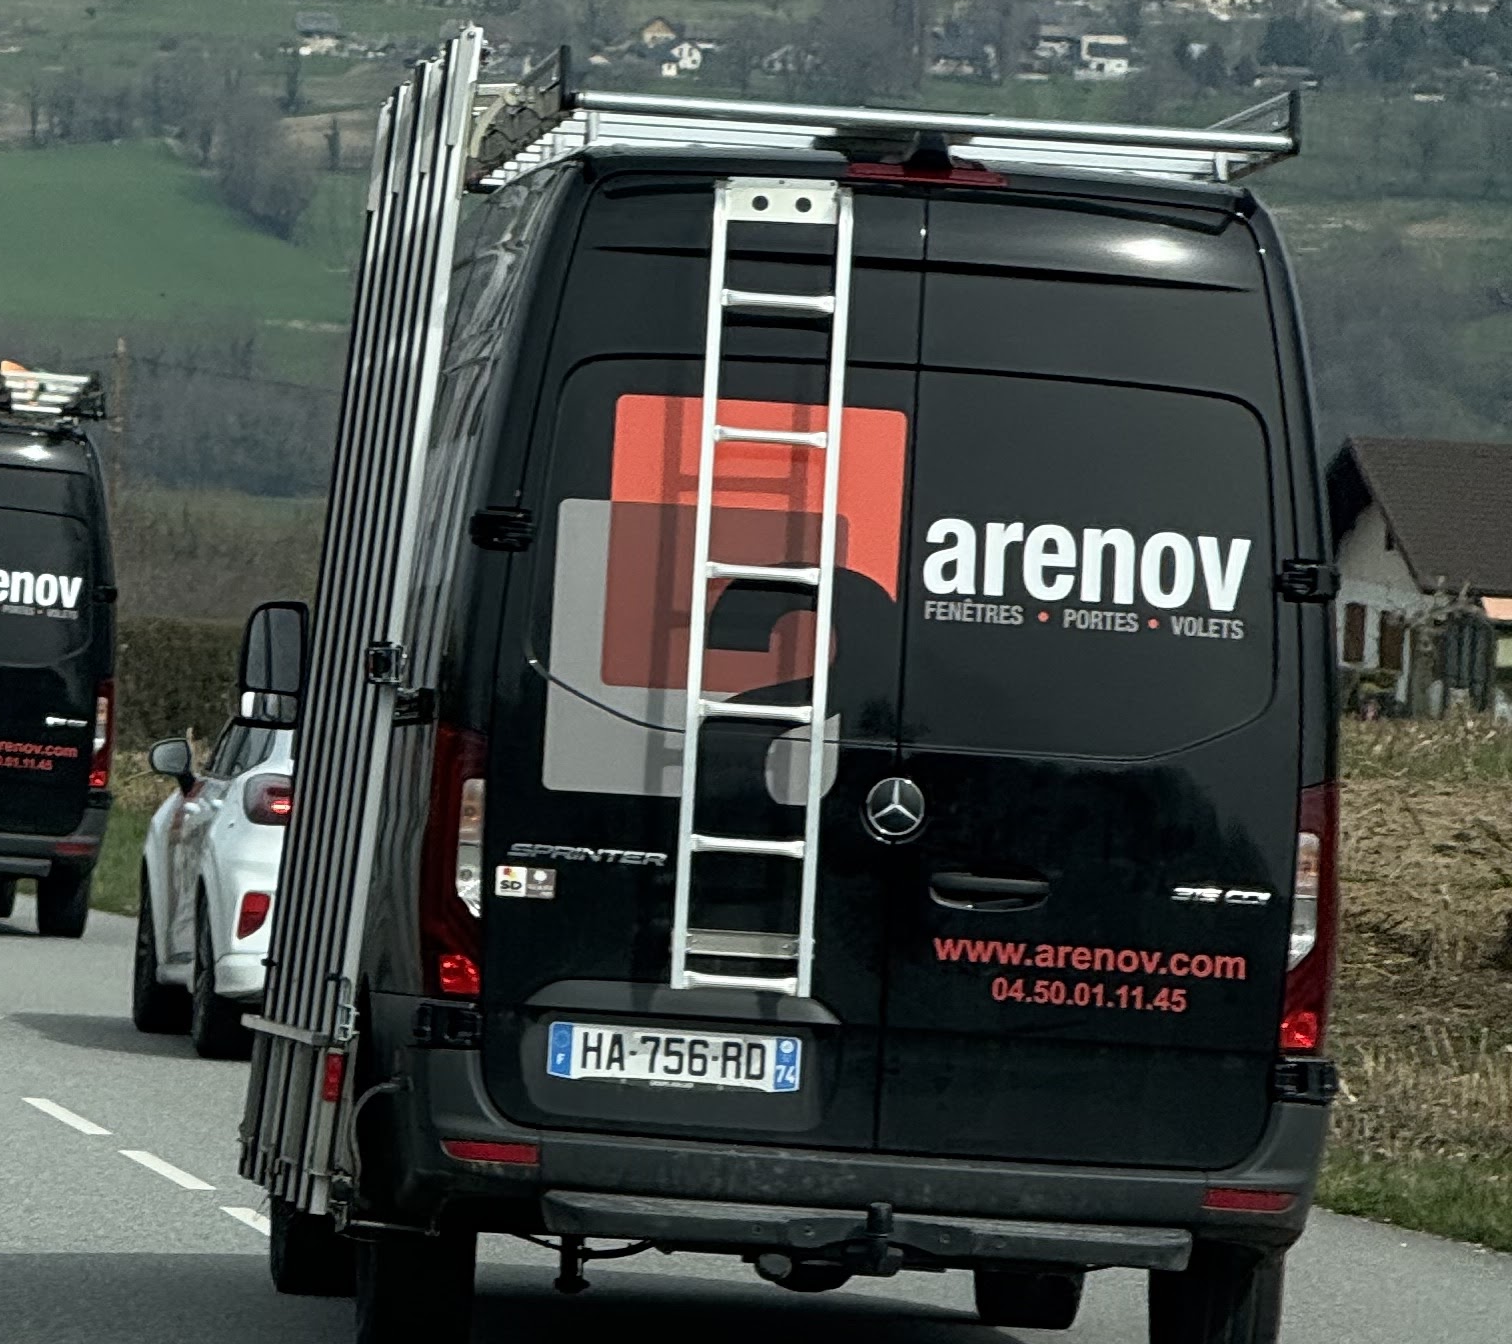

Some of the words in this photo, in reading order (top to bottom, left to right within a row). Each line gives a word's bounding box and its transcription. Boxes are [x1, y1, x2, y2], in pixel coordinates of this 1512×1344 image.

[922, 518, 1252, 612] arenov
[924, 598, 1025, 626] FENÊTRES
[1063, 608, 1140, 633] PORTES
[1170, 615, 1245, 640] VOLETS
[507, 842, 668, 867] SPRINTER
[933, 937, 1246, 980] www.arenov.com
[991, 976, 1188, 1013] 04.50.01.11.45
[580, 1031, 766, 1081] HA-756-RD
[775, 1064, 796, 1084] 74
